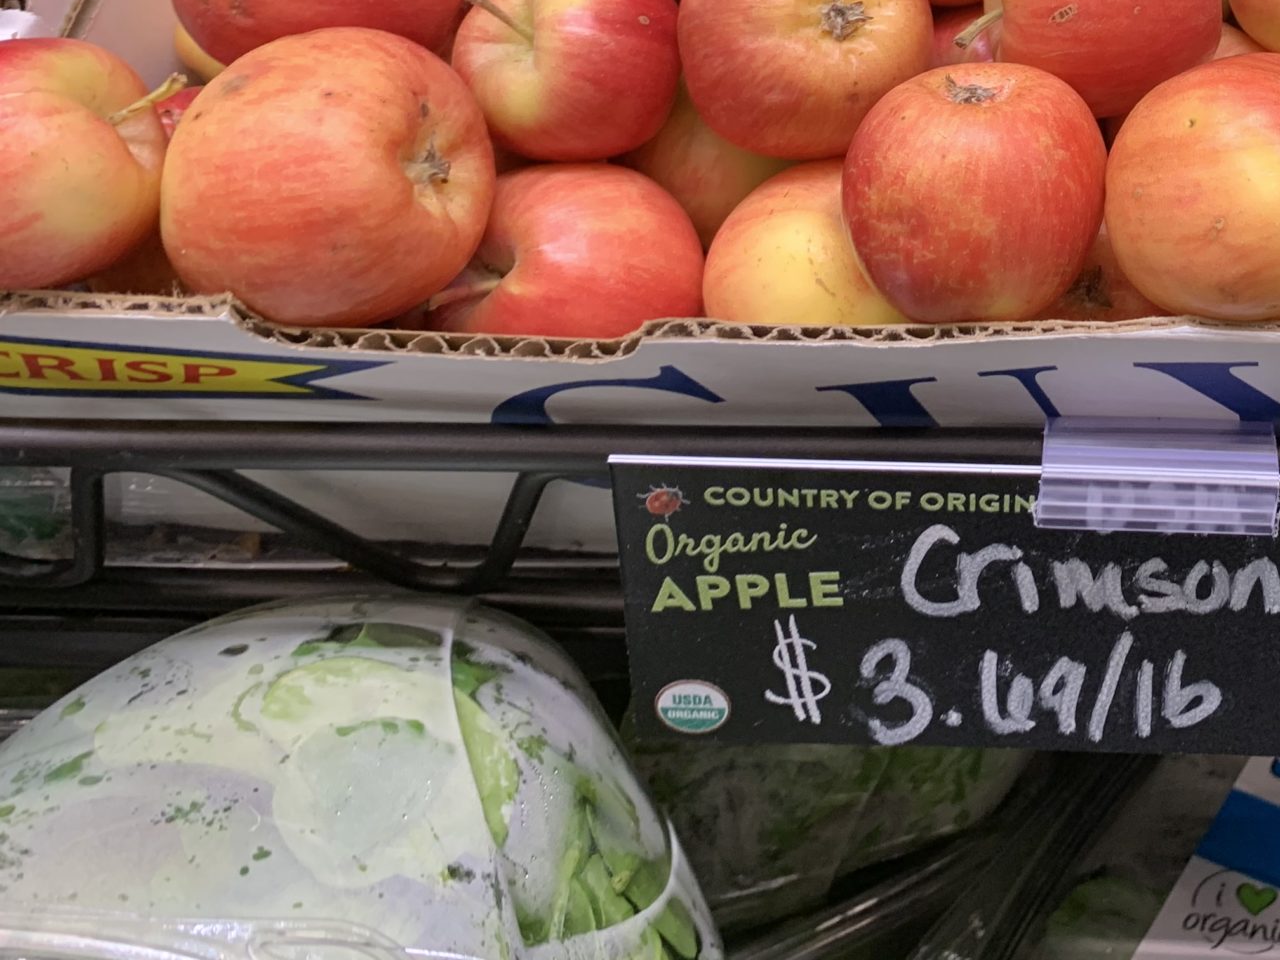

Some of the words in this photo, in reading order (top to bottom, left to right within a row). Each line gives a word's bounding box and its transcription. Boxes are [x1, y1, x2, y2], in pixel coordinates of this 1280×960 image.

[704, 486, 860, 510] COUNTRY
[868, 490, 911, 512] OF
[920, 491, 1036, 513] ORIGIN
[645, 522, 817, 572] Organic
[650, 571, 844, 613] APPLE
[764, 614, 832, 725] $
[671, 693, 714, 707] USDA
[667, 709, 720, 720] ORGANIC
[1214, 883, 1226, 904] i
